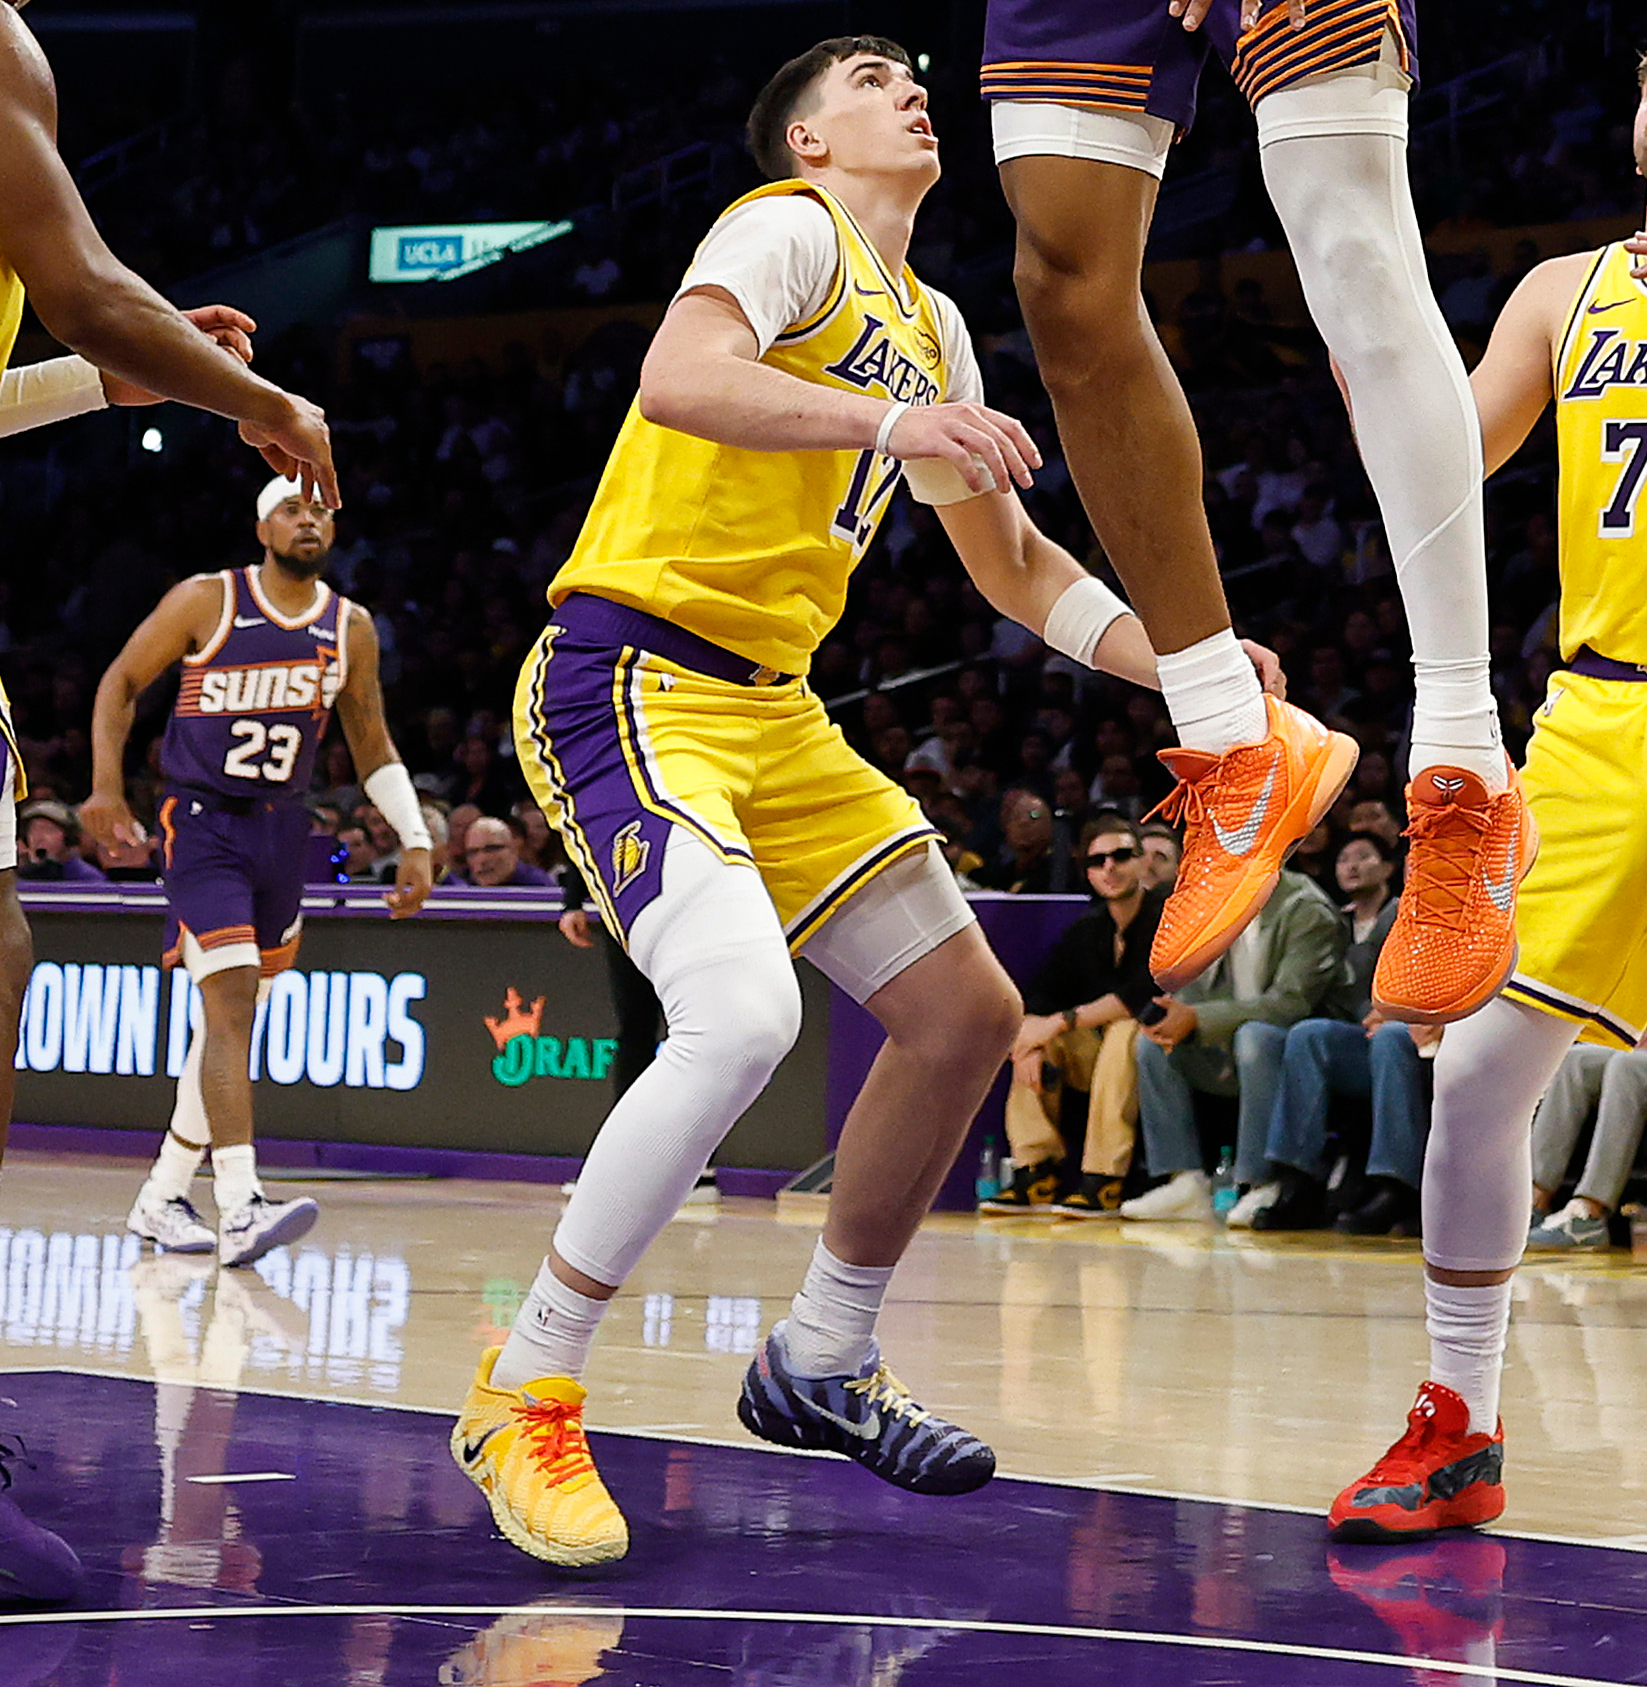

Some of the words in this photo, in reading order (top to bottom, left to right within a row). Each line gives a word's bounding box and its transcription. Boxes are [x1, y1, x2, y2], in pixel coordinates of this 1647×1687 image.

[404, 241, 457, 265] UCLA
[199, 665, 321, 713] SUNS
[223, 718, 302, 782] 23
